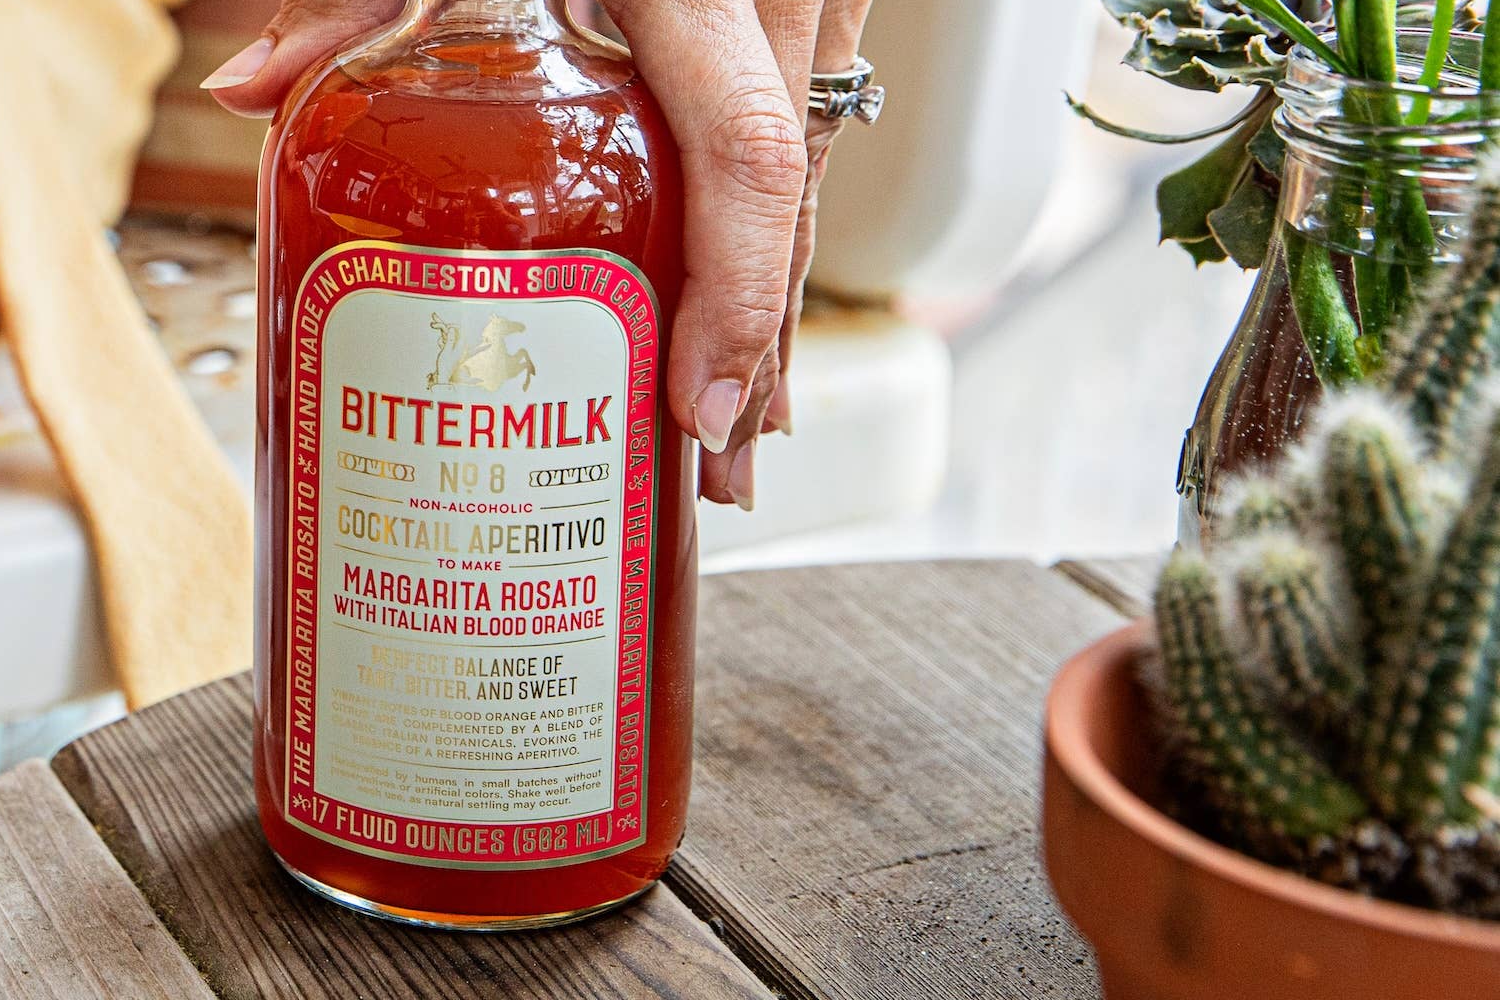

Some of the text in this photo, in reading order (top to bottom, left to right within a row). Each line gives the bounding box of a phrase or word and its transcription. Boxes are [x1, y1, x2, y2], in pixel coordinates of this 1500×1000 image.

[312, 268, 341, 304] IN
[527, 264, 612, 296] SOUTH
[299, 297, 325, 375] MADE
[298, 379, 317, 453] HAND
[341, 385, 613, 449] BITTERMILK
[630, 417, 651, 470] USA
[489, 462, 506, 494] 8
[410, 498, 534, 514] NON-ALCOHOLIC
[337, 504, 606, 555] COCKTAIL APERITIVO
[437, 558, 502, 571] TO MAKE
[344, 562, 597, 612] MARGARITA ROSATO
[333, 594, 605, 636] WITH ITALIAN BLOOD ORANGE
[293, 482, 316, 787] THE MARGARITA ROSATO
[454, 657, 537, 677] BALANCE
[543, 655, 564, 675] OF
[616, 497, 647, 810] THE MARGARITA ROSATO
[476, 681, 513, 700] AND
[518, 676, 577, 700] SWEET
[403, 719, 504, 735] COMPLEMENTED
[511, 725, 526, 735] BY
[532, 724, 541, 733] A
[547, 719, 584, 732] BLEND
[589, 716, 603, 726] OF
[420, 708, 437, 718] OF
[439, 709, 481, 721] BLOOD
[485, 711, 537, 721] ORANGE
[540, 709, 564, 719] AND
[567, 702, 604, 717] BITTER
[405, 745, 420, 756] OF
[424, 748, 433, 757] A
[437, 749, 513, 761] REFRESHING
[517, 746, 580, 760] APERITIVO.
[523, 734, 577, 747] EVOKING
[583, 729, 603, 740] THE
[395, 769, 602, 788] by humans in small batches without
[400, 784, 411, 792] or
[415, 786, 460, 797] artificial
[507, 789, 541, 799] Shake
[545, 786, 566, 796] well
[569, 781, 602, 793] before
[409, 796, 422, 804] as
[425, 797, 464, 808] natural
[467, 800, 509, 811] settling
[513, 802, 537, 811] may
[539, 798, 572, 808] occur.
[312, 796, 613, 856] 17 FLUID OUNCES (502 ML)
